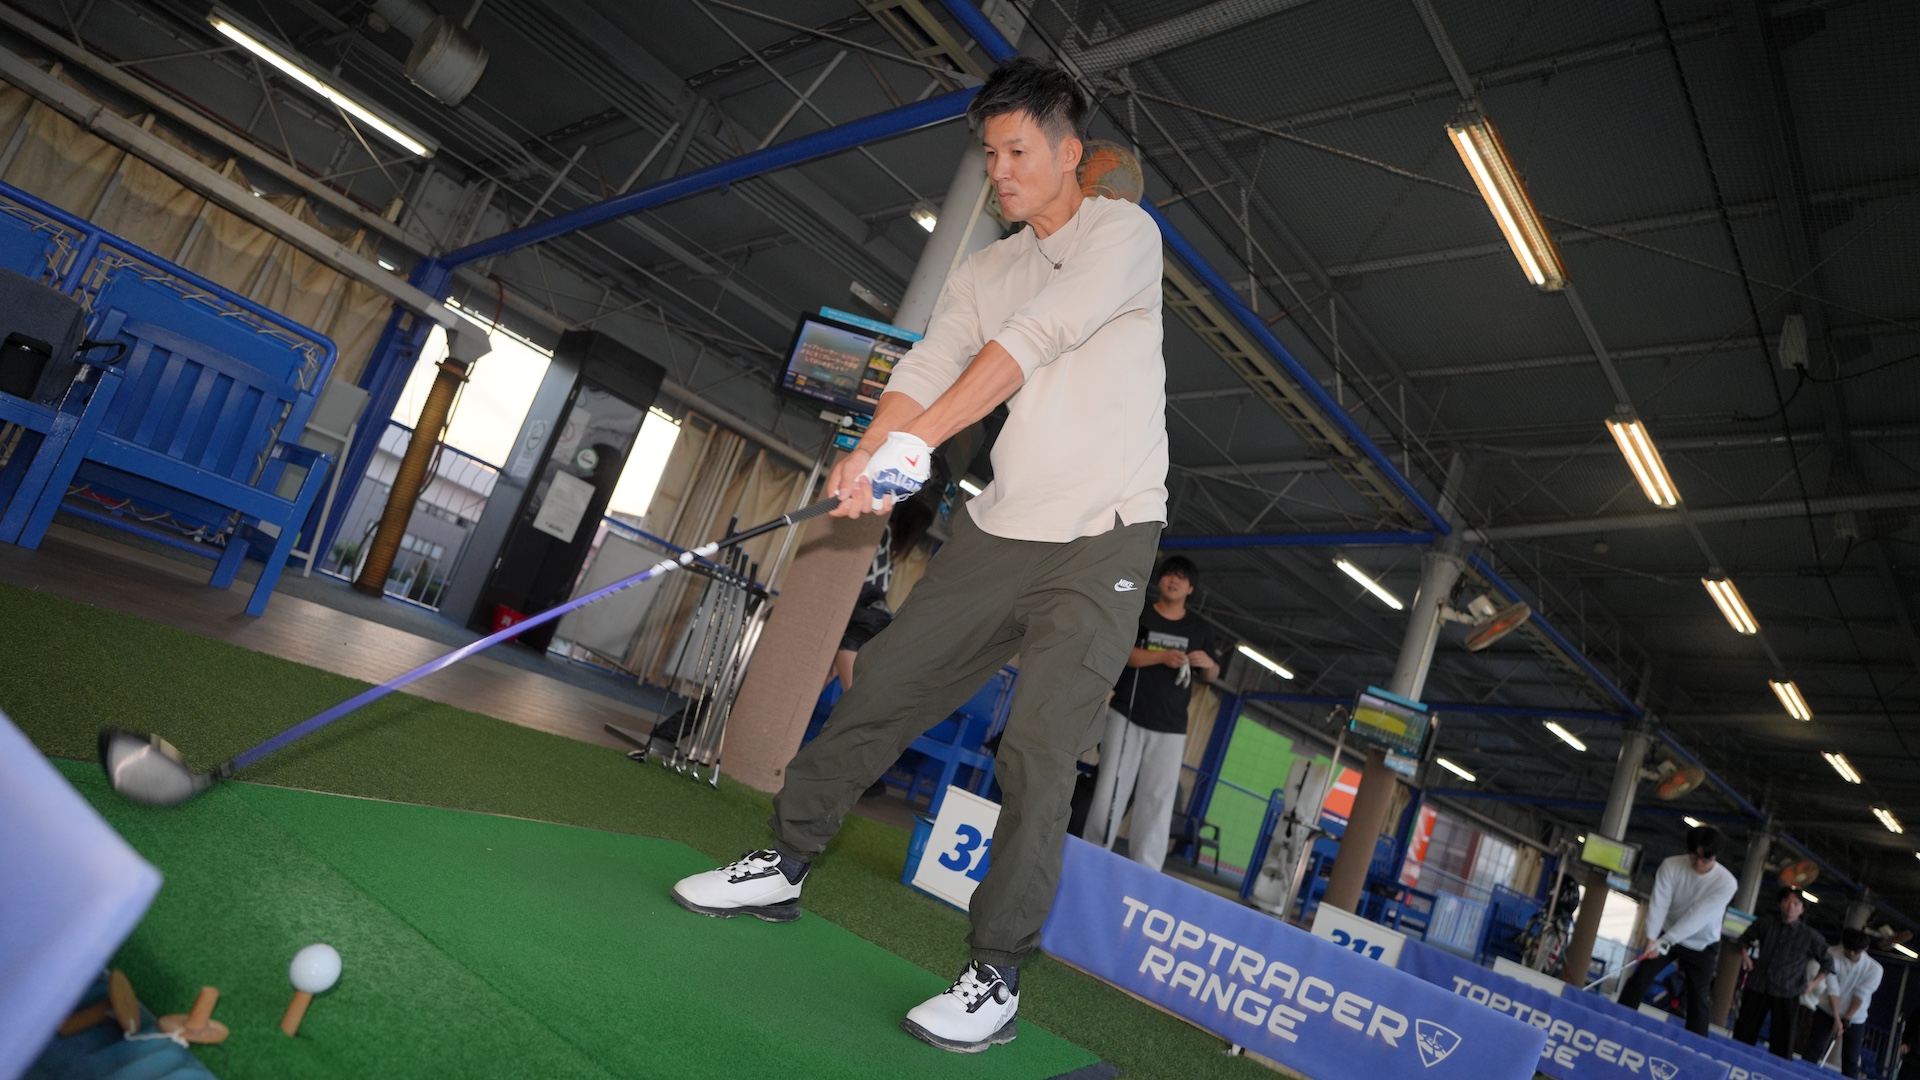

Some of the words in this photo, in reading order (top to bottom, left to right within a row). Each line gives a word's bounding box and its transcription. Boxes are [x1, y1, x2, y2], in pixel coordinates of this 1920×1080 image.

[1118, 578, 1135, 589] NIKE
[938, 823, 992, 882] 31
[1122, 895, 1409, 1048] TOPTRACER
[1138, 946, 1307, 1043] RANGE
[1452, 975, 1645, 1074] TOPTRACER
